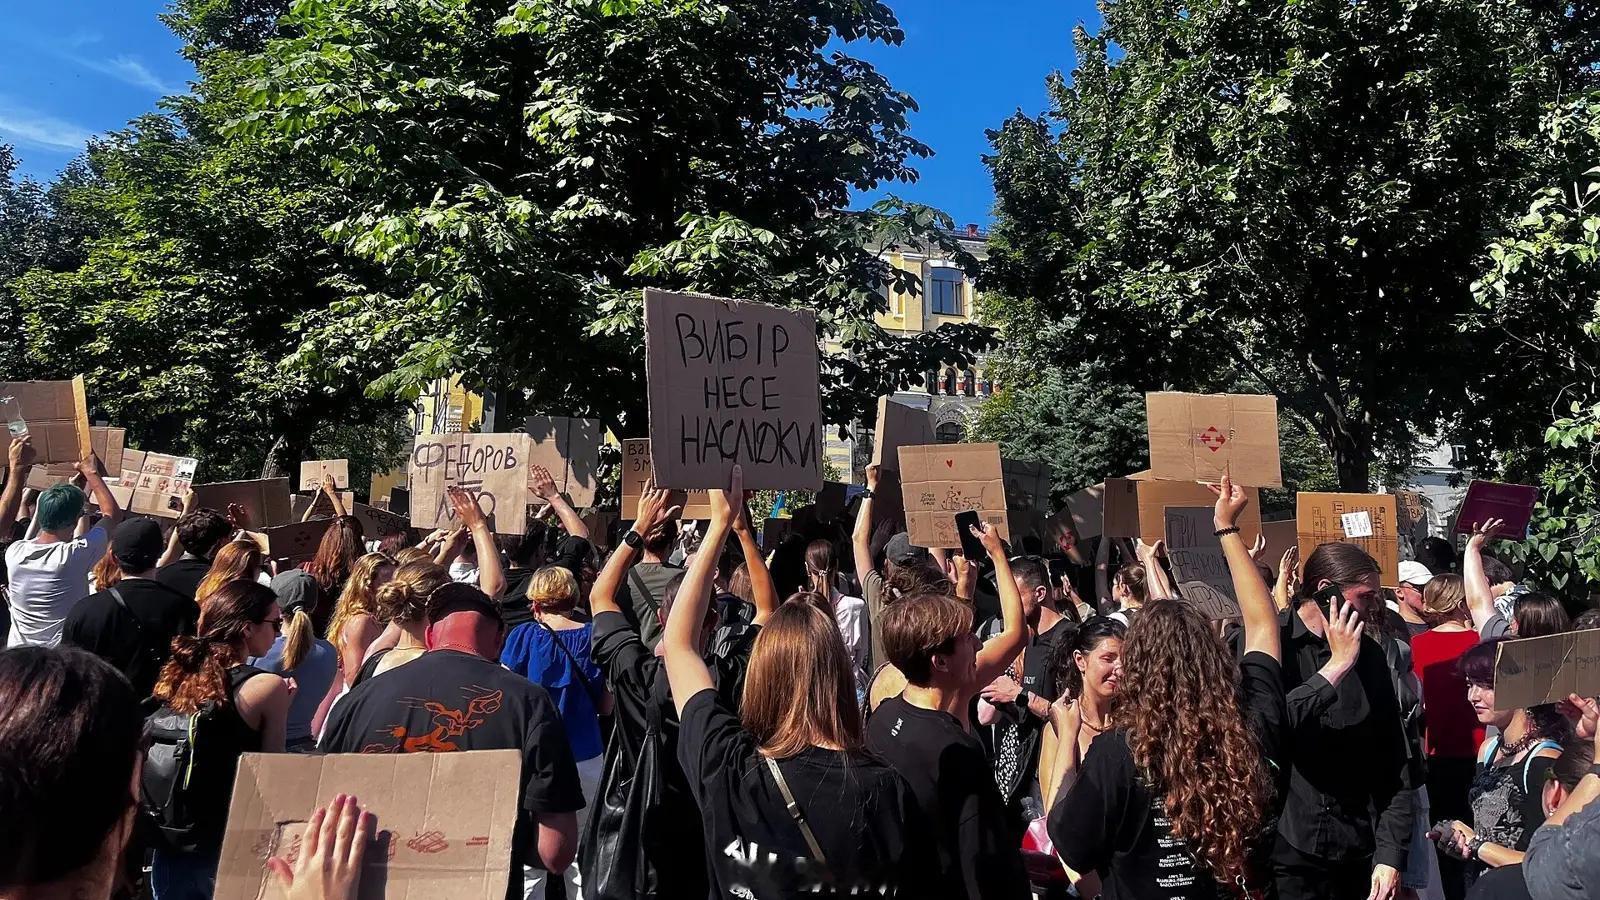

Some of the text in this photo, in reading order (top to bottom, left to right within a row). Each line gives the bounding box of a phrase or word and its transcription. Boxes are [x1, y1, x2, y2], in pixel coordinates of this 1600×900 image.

[675, 312, 790, 367] ВИБІР
[703, 376, 781, 411] НЕСЕ
[414, 442, 517, 483] ФЕДОРОВ
